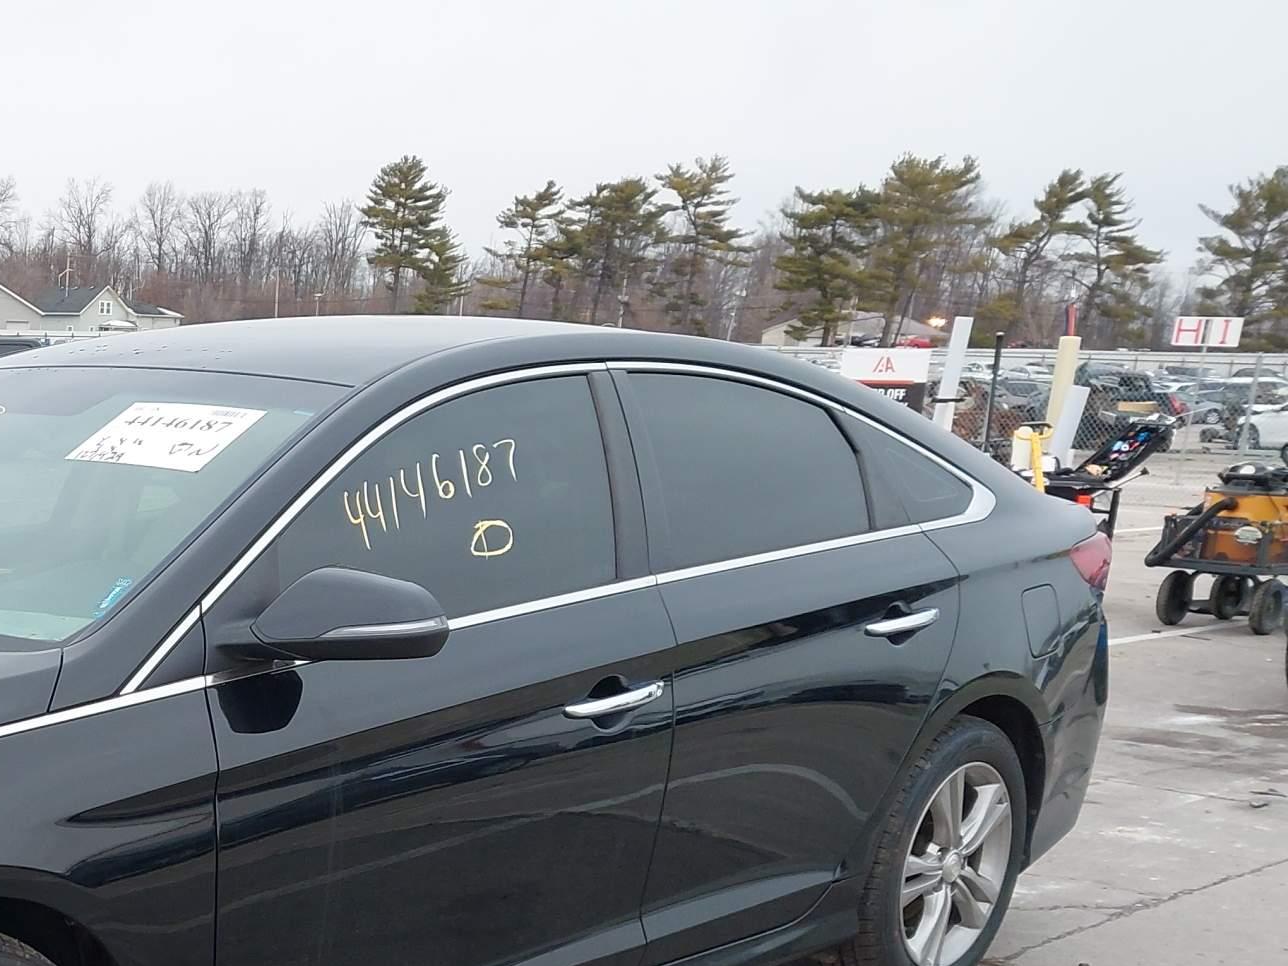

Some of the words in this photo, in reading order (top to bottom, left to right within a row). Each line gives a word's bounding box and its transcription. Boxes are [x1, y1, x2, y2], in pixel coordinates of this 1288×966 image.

[887, 388, 906, 400] OFF
[123, 415, 233, 433] 44146187
[343, 439, 519, 551] 44146187
